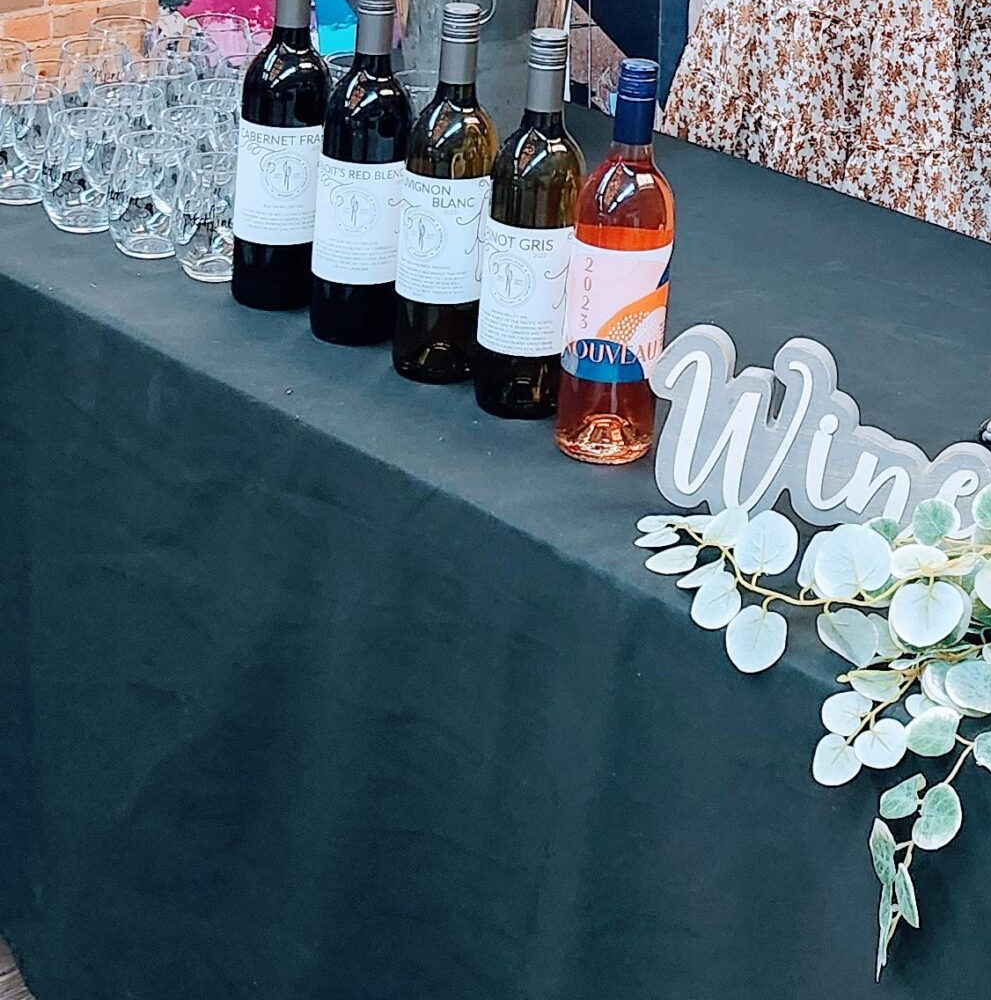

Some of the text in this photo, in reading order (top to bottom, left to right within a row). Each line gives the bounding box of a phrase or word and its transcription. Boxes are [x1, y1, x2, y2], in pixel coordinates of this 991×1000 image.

[348, 169, 371, 180] RED
[432, 198, 475, 209] BLANC
[519, 239, 553, 252] GRIS
[580, 256, 594, 330] 2023
[562, 337, 659, 365] NOUVEAU
[664, 350, 979, 540] Wine
